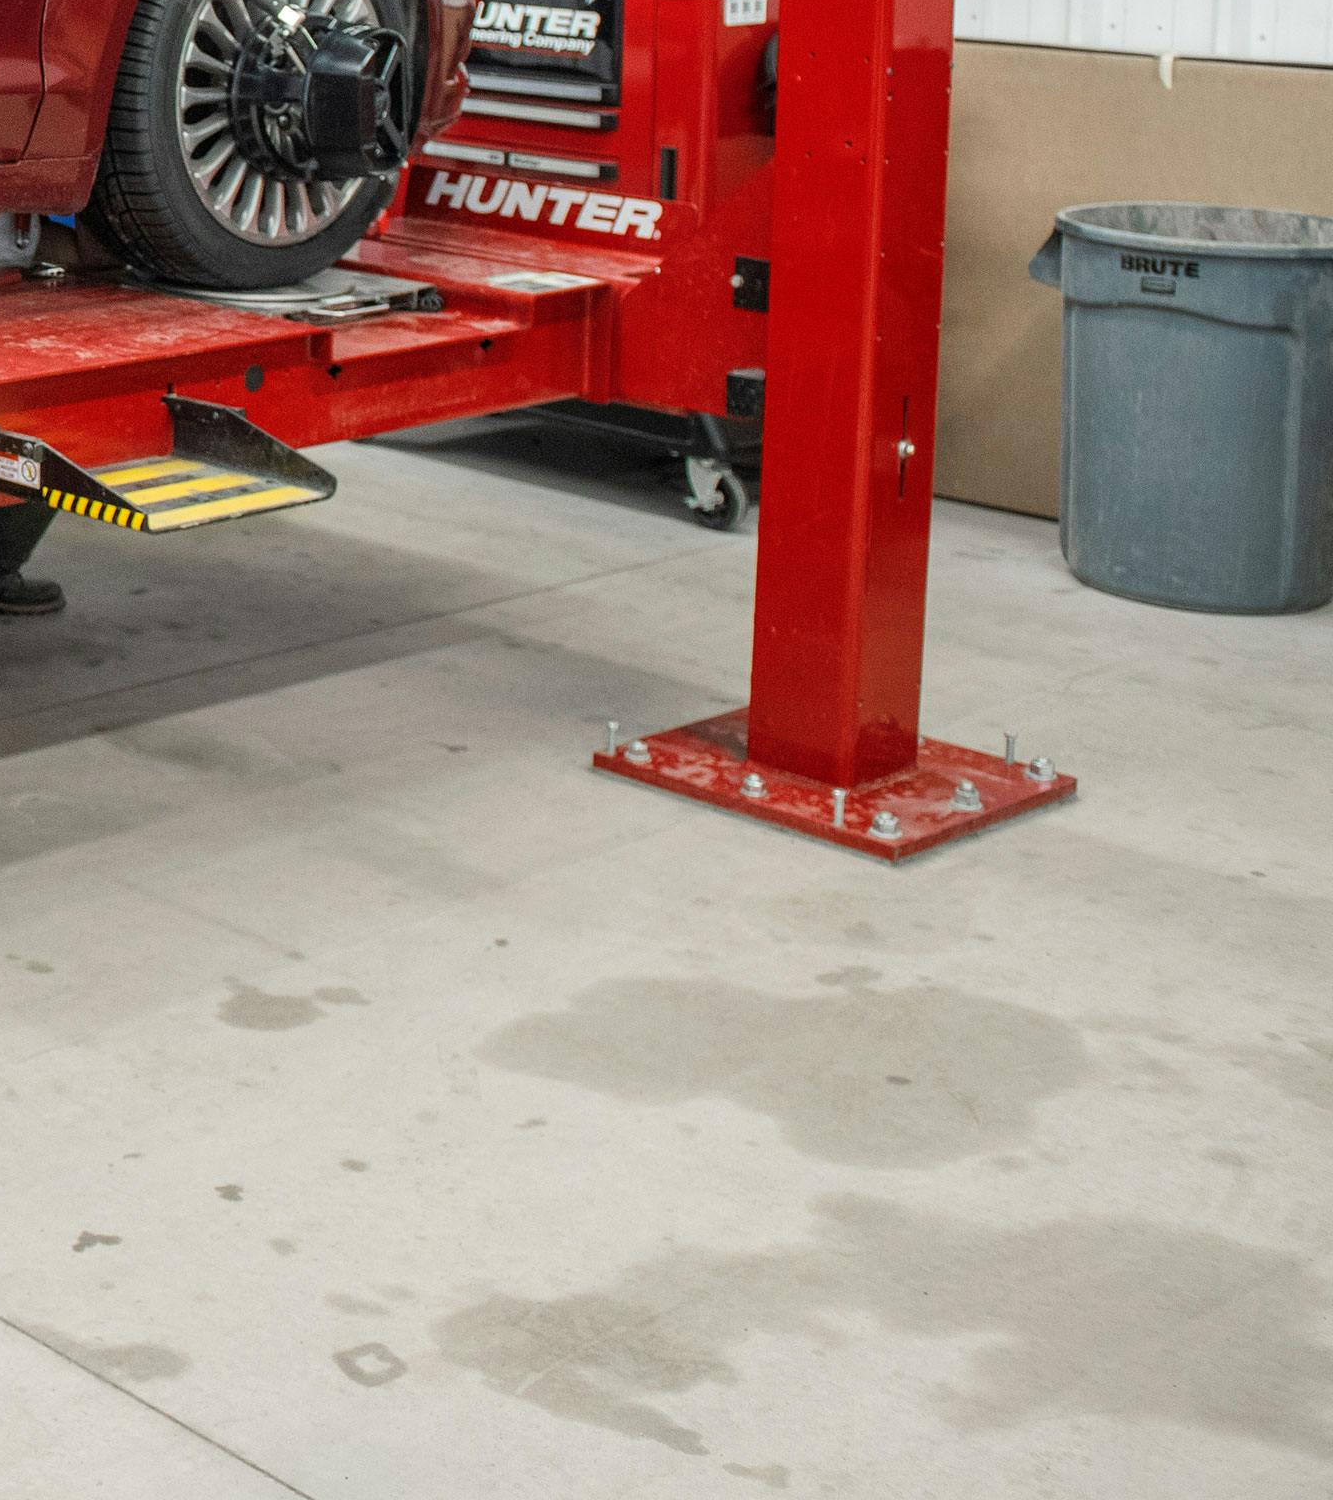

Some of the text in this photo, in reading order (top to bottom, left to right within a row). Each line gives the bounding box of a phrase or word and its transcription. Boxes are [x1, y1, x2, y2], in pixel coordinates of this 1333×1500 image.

[473, 0, 601, 39] UNTER
[469, 28, 596, 56] neering Company
[425, 170, 663, 239] HUNTER
[1120, 254, 1201, 278] BRUTE
